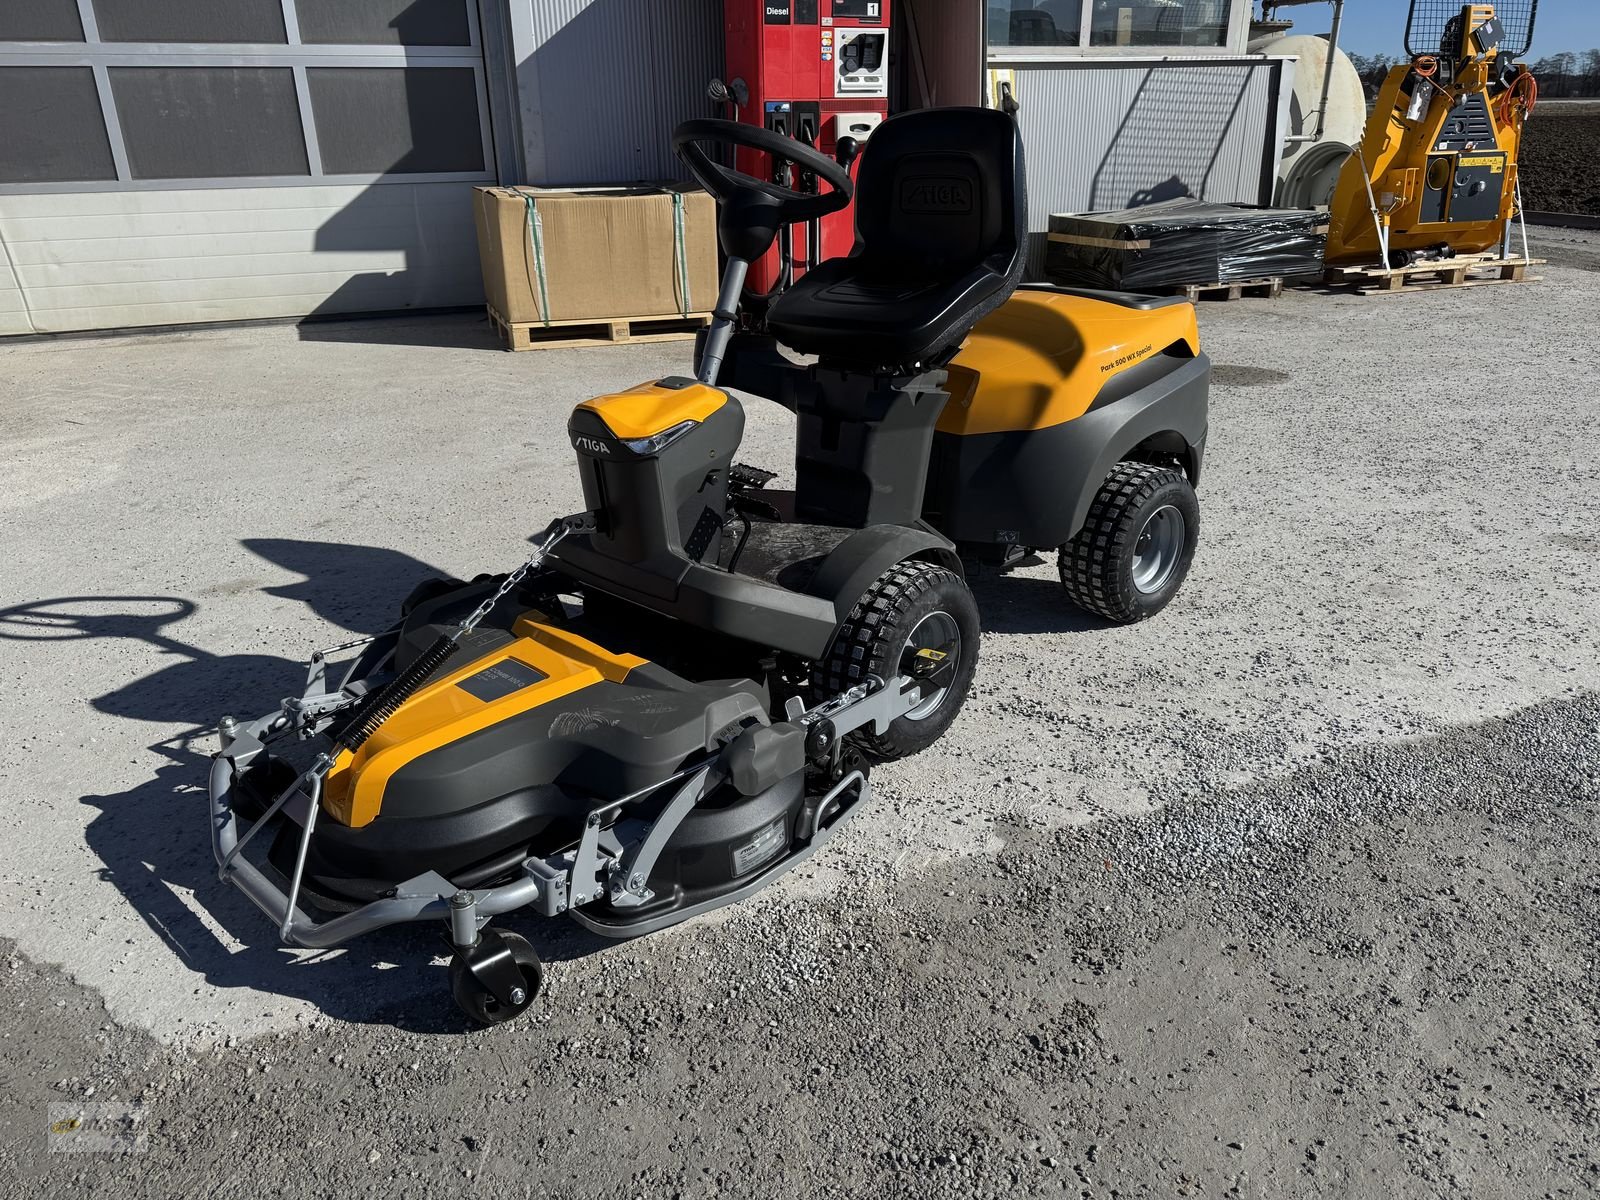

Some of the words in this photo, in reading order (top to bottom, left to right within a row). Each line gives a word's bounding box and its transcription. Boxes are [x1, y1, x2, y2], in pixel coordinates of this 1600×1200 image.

[766, 7, 789, 15] Diesel
[1100, 362, 1115, 373] Park
[1115, 356, 1127, 367] 500
[1126, 352, 1136, 362] WX
[1136, 344, 1152, 358] Special
